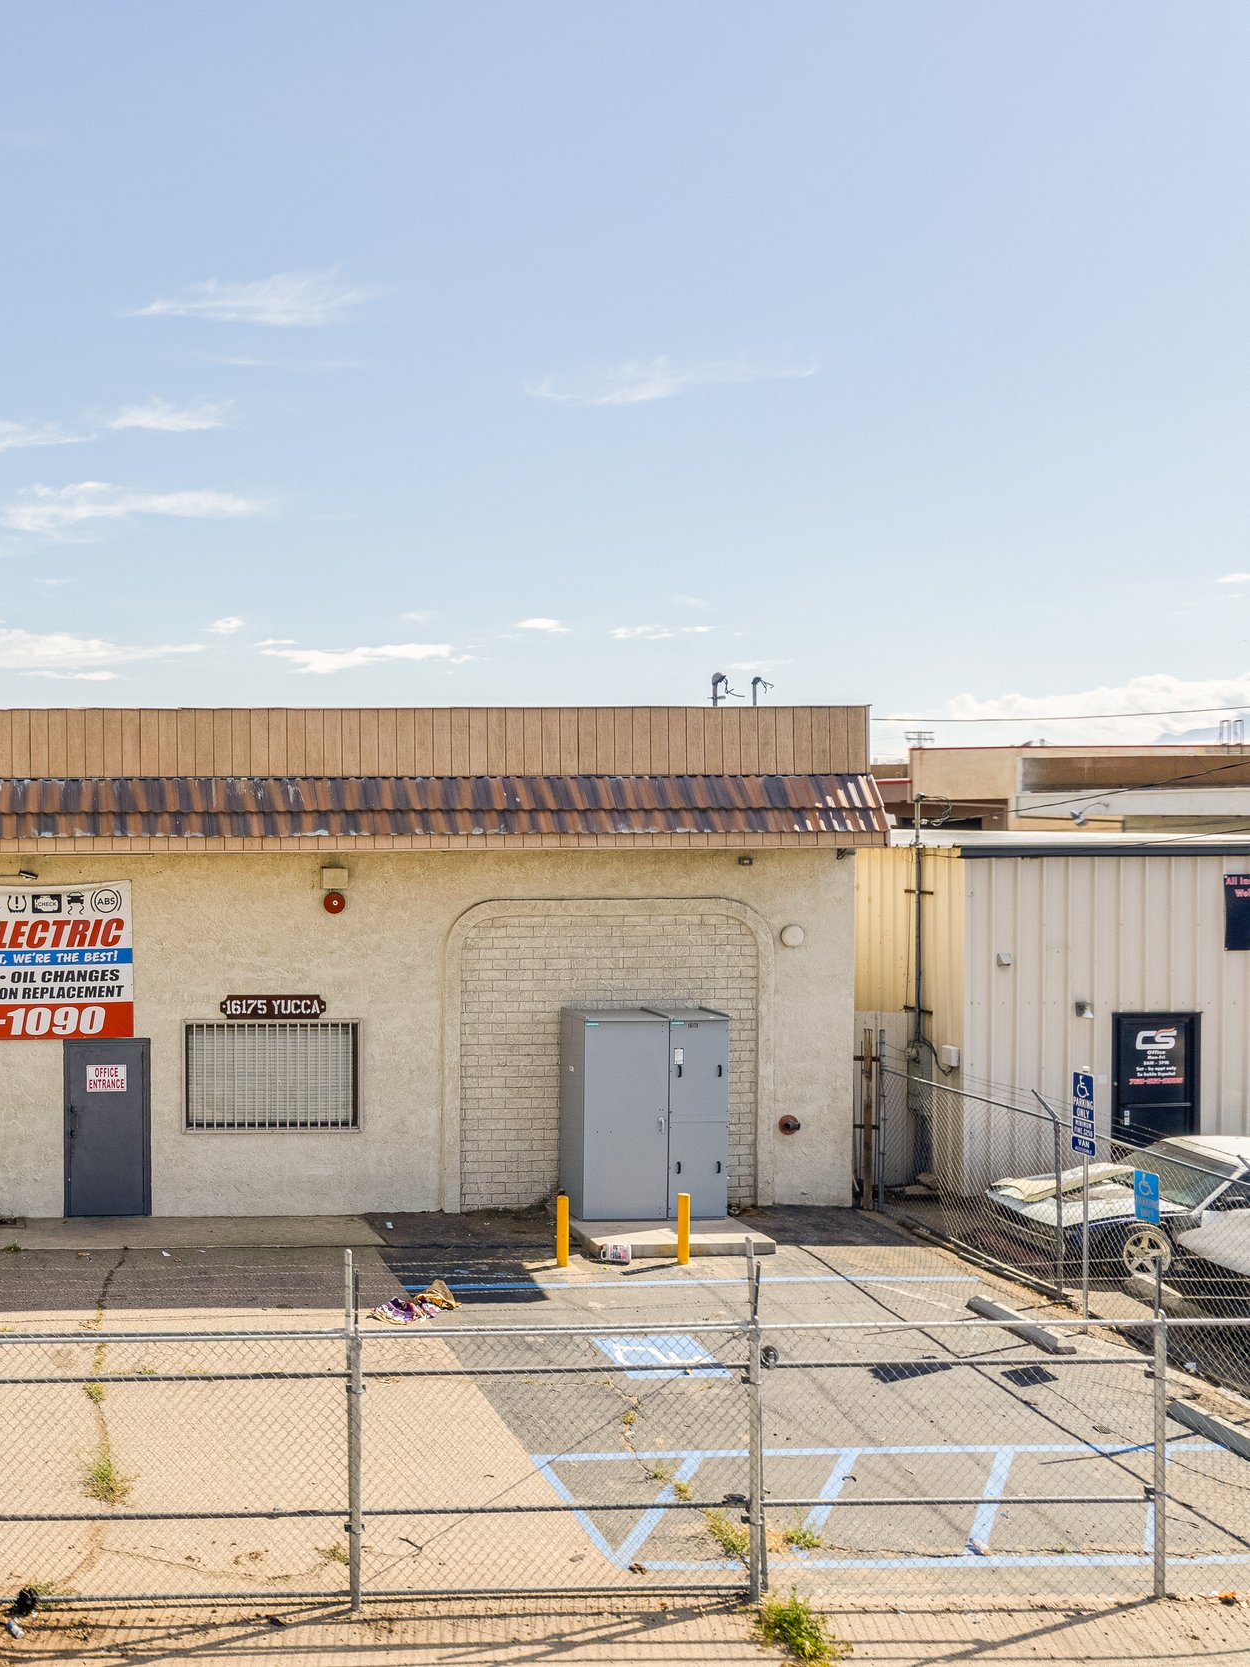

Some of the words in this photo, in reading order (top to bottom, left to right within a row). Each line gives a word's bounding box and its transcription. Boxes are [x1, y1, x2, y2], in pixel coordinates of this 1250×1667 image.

[97, 897, 116, 905] ABS
[13, 952, 51, 963] WE'RE
[56, 952, 80, 962] THE
[84, 950, 118, 962] BEST!
[10, 971, 37, 983] OIL
[40, 969, 120, 983] CHANGES
[22, 985, 125, 1000] REPLACEMENT
[226, 999, 268, 1015] 16175
[271, 1000, 321, 1015] YUCCA
[1135, 1028, 1178, 1050] CS
[94, 1067, 119, 1078] OFFICE
[89, 1079, 125, 1089] ENTRANCE
[1073, 1096, 1094, 1111] PARKING
[1076, 1108, 1090, 1119] ONLY
[1077, 1138, 1090, 1149] VAN
